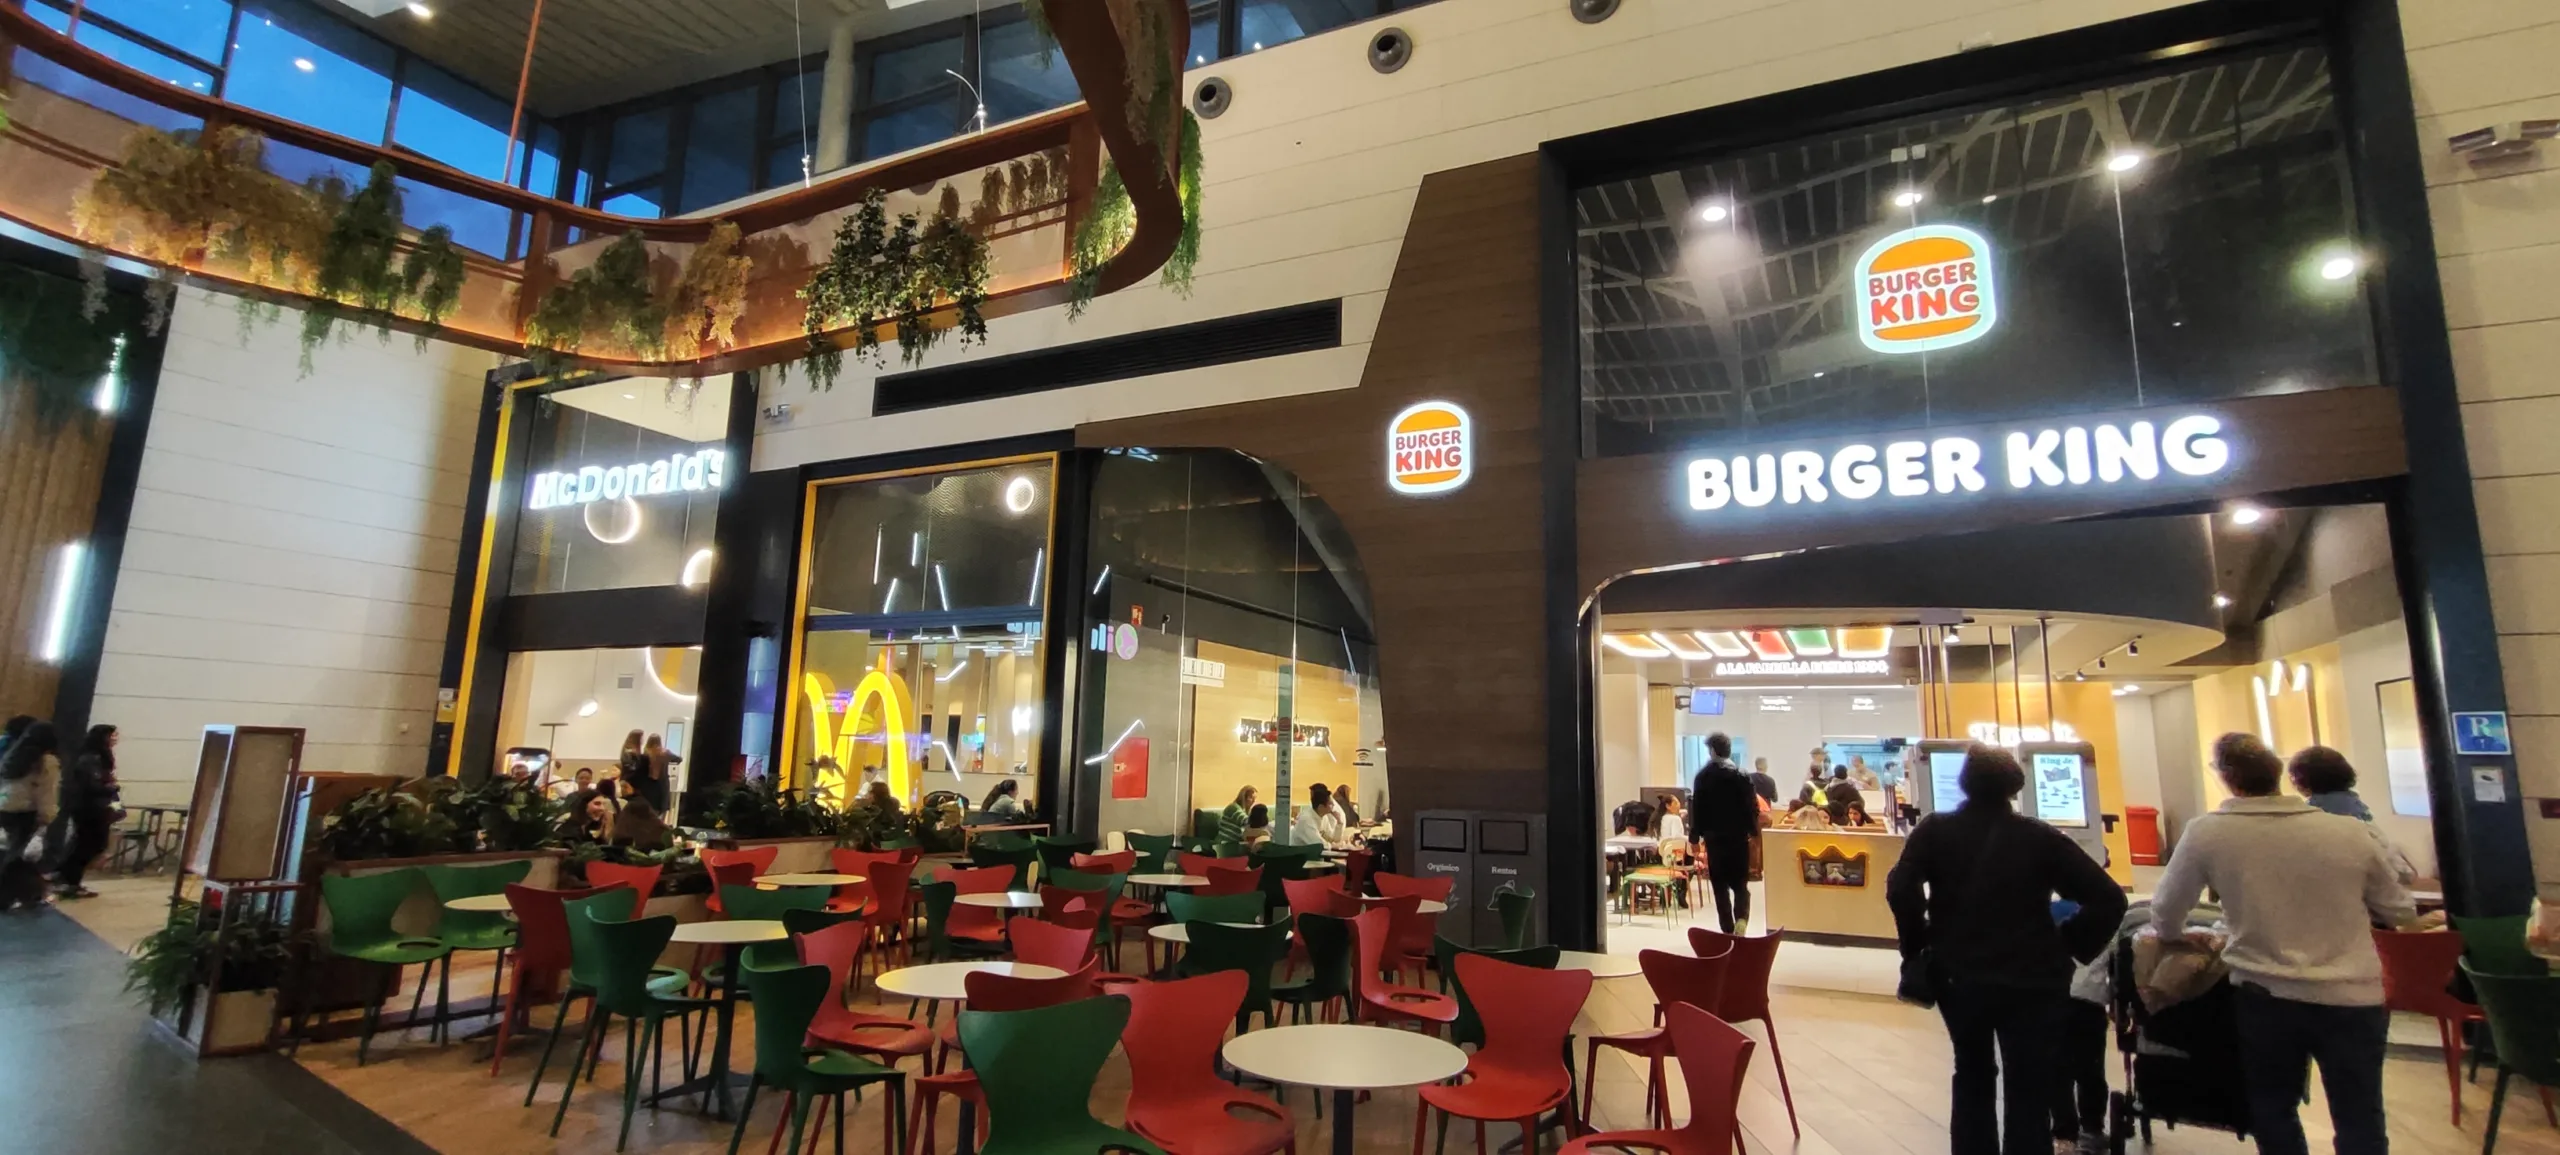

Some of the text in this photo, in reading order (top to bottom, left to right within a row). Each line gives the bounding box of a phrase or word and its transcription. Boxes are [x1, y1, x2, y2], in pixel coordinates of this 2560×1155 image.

[1869, 262, 1978, 297] BURGER
[1871, 284, 1980, 326] KING
[1396, 430, 1461, 450] BURGER
[1396, 446, 1462, 472] KING
[530, 448, 725, 510] McDonald's
[1687, 415, 2229, 511] BURGER KING
